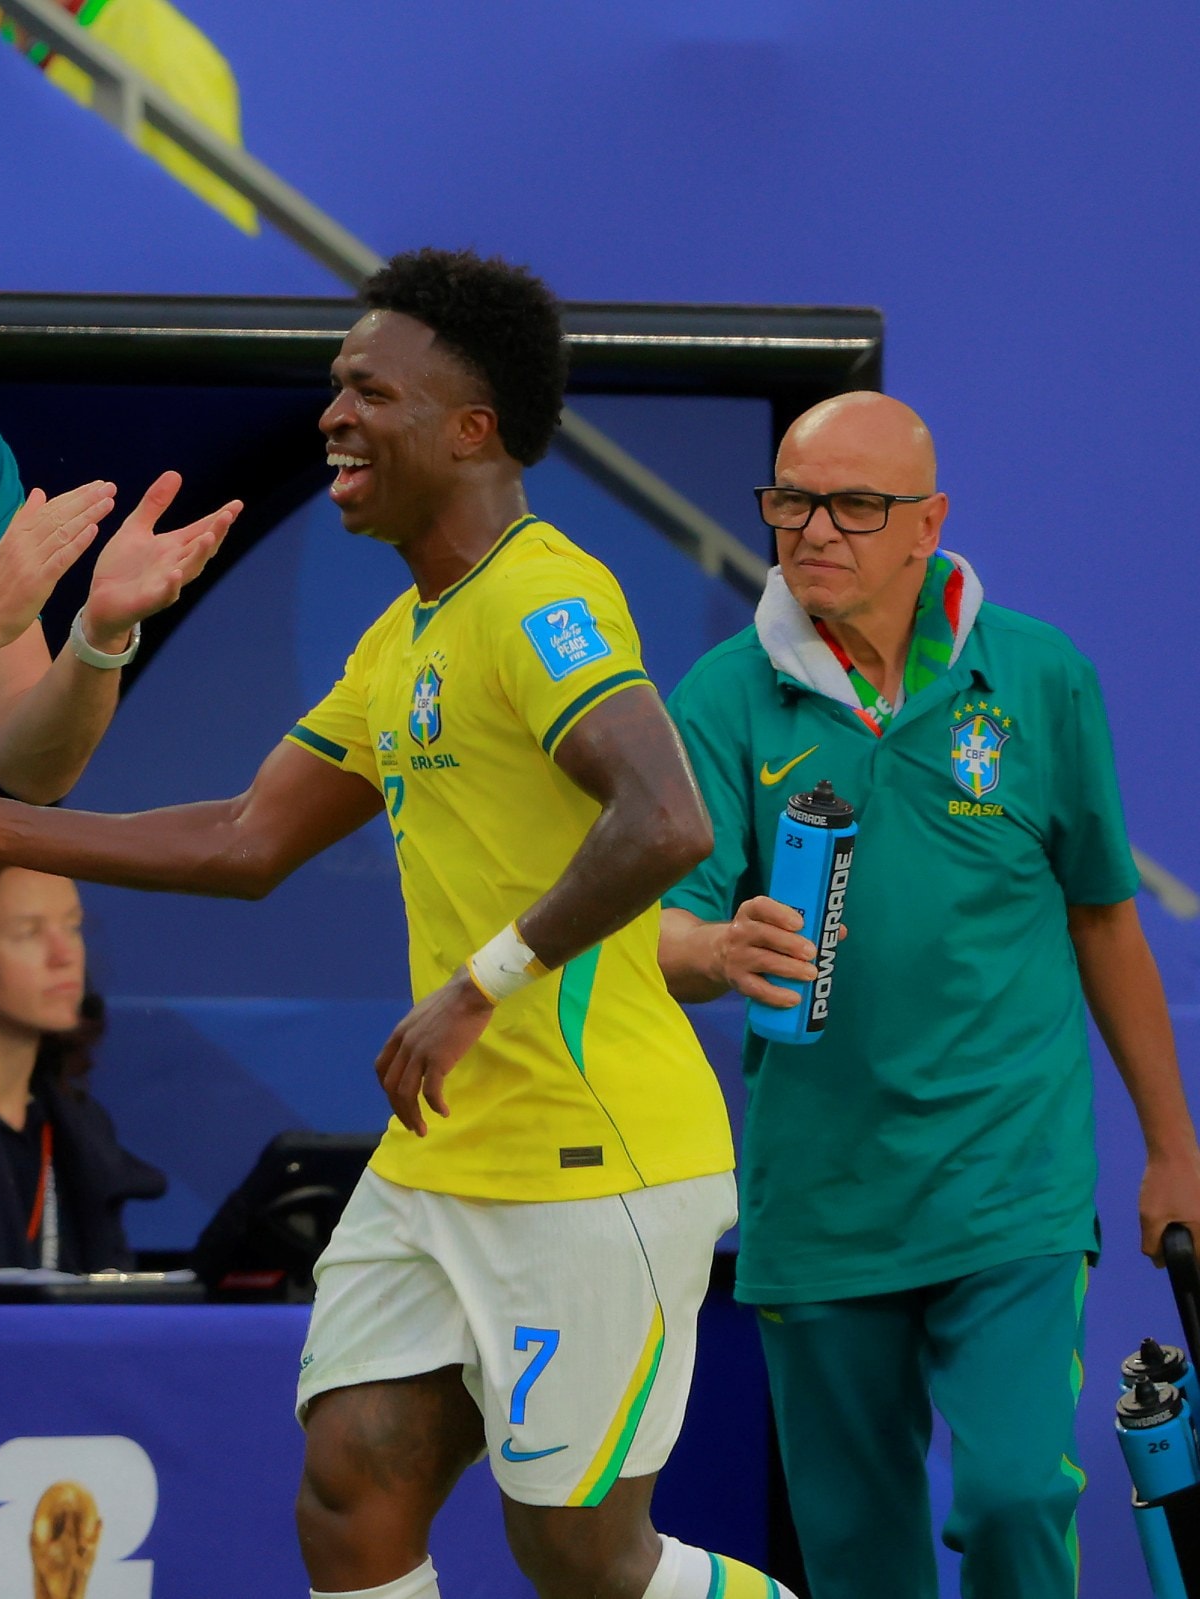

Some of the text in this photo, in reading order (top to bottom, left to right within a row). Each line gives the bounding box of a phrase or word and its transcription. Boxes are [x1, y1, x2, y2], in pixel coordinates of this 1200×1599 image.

[557, 635, 589, 658] PEACE
[569, 650, 587, 662] FIFA
[418, 699, 430, 709] CBF
[411, 754, 460, 771] BRASIL
[965, 748, 986, 762] CBF
[948, 800, 1004, 817] BRASIL
[785, 833, 803, 849] 23
[812, 851, 853, 1021] POWERADE
[509, 1325, 560, 1425] 7
[1147, 1439, 1170, 1454] 26
